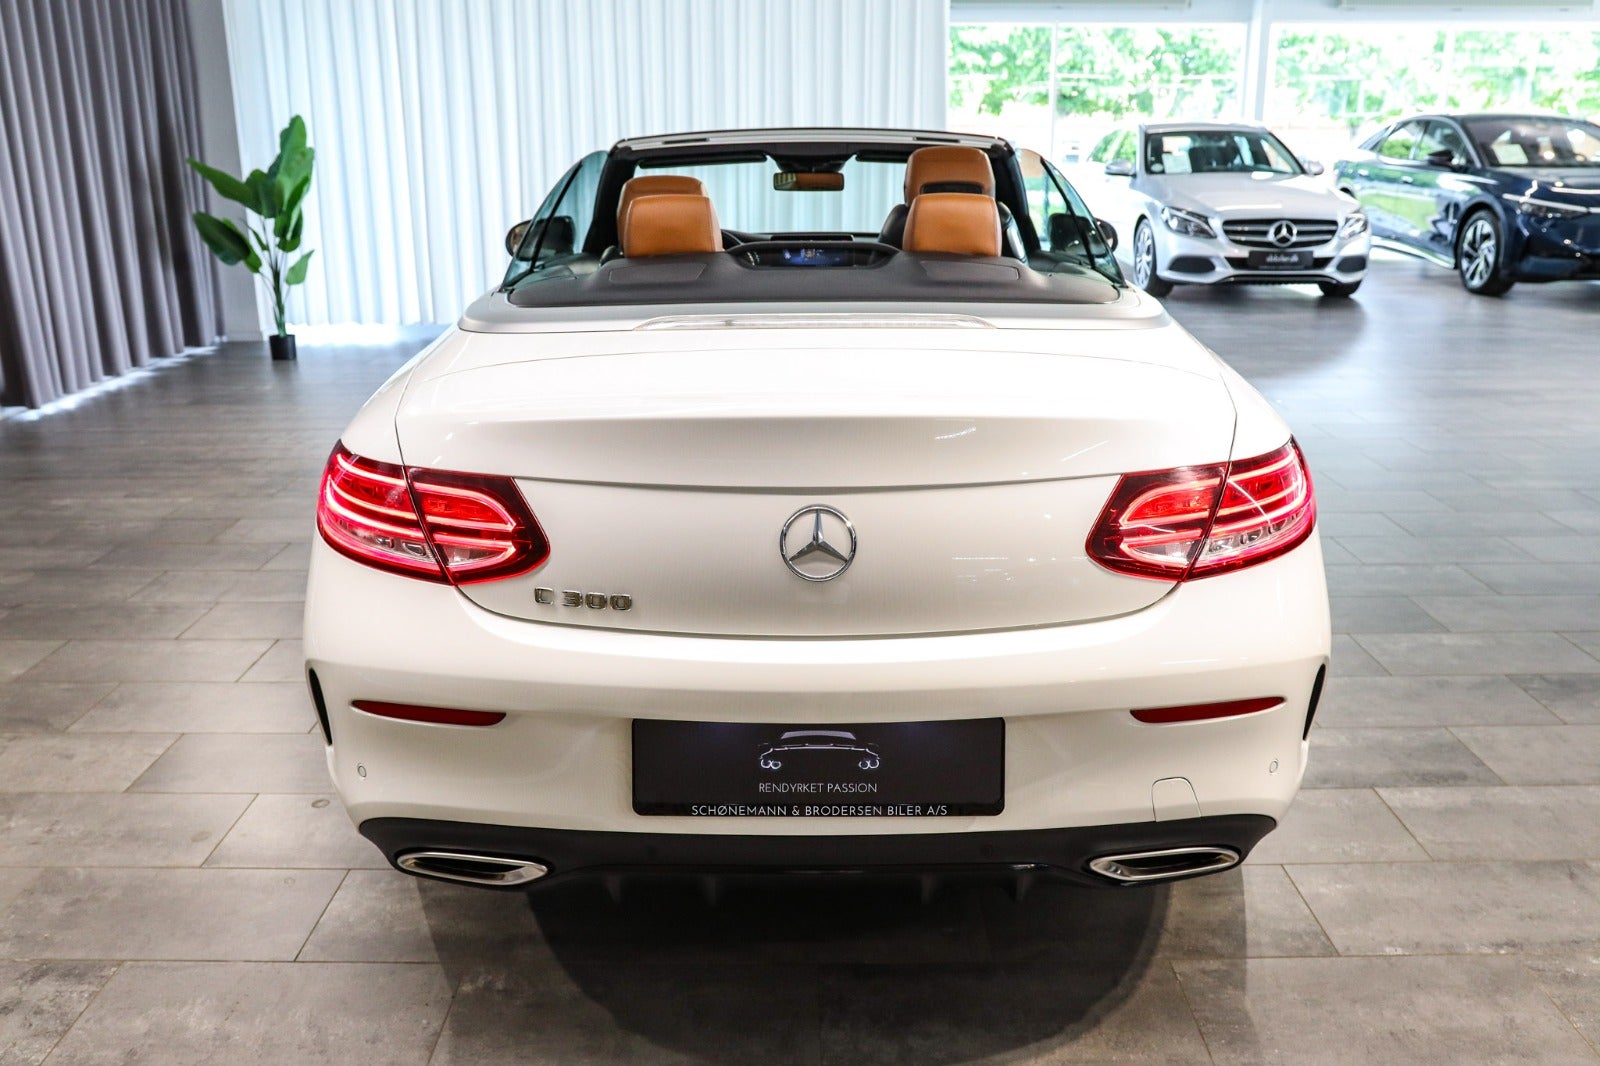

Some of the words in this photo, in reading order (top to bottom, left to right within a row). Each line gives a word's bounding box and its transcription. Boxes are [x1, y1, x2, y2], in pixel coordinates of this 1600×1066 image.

[534, 586, 554, 605] C
[562, 589, 633, 611] 300
[758, 782, 824, 793] RENDYRKET
[827, 782, 878, 793] PASSION
[691, 805, 787, 816] SCHØNEMANN
[791, 805, 800, 816] &
[805, 805, 882, 816] BRODERSEN
[887, 805, 922, 816] BILER
[926, 805, 948, 816] A/S
